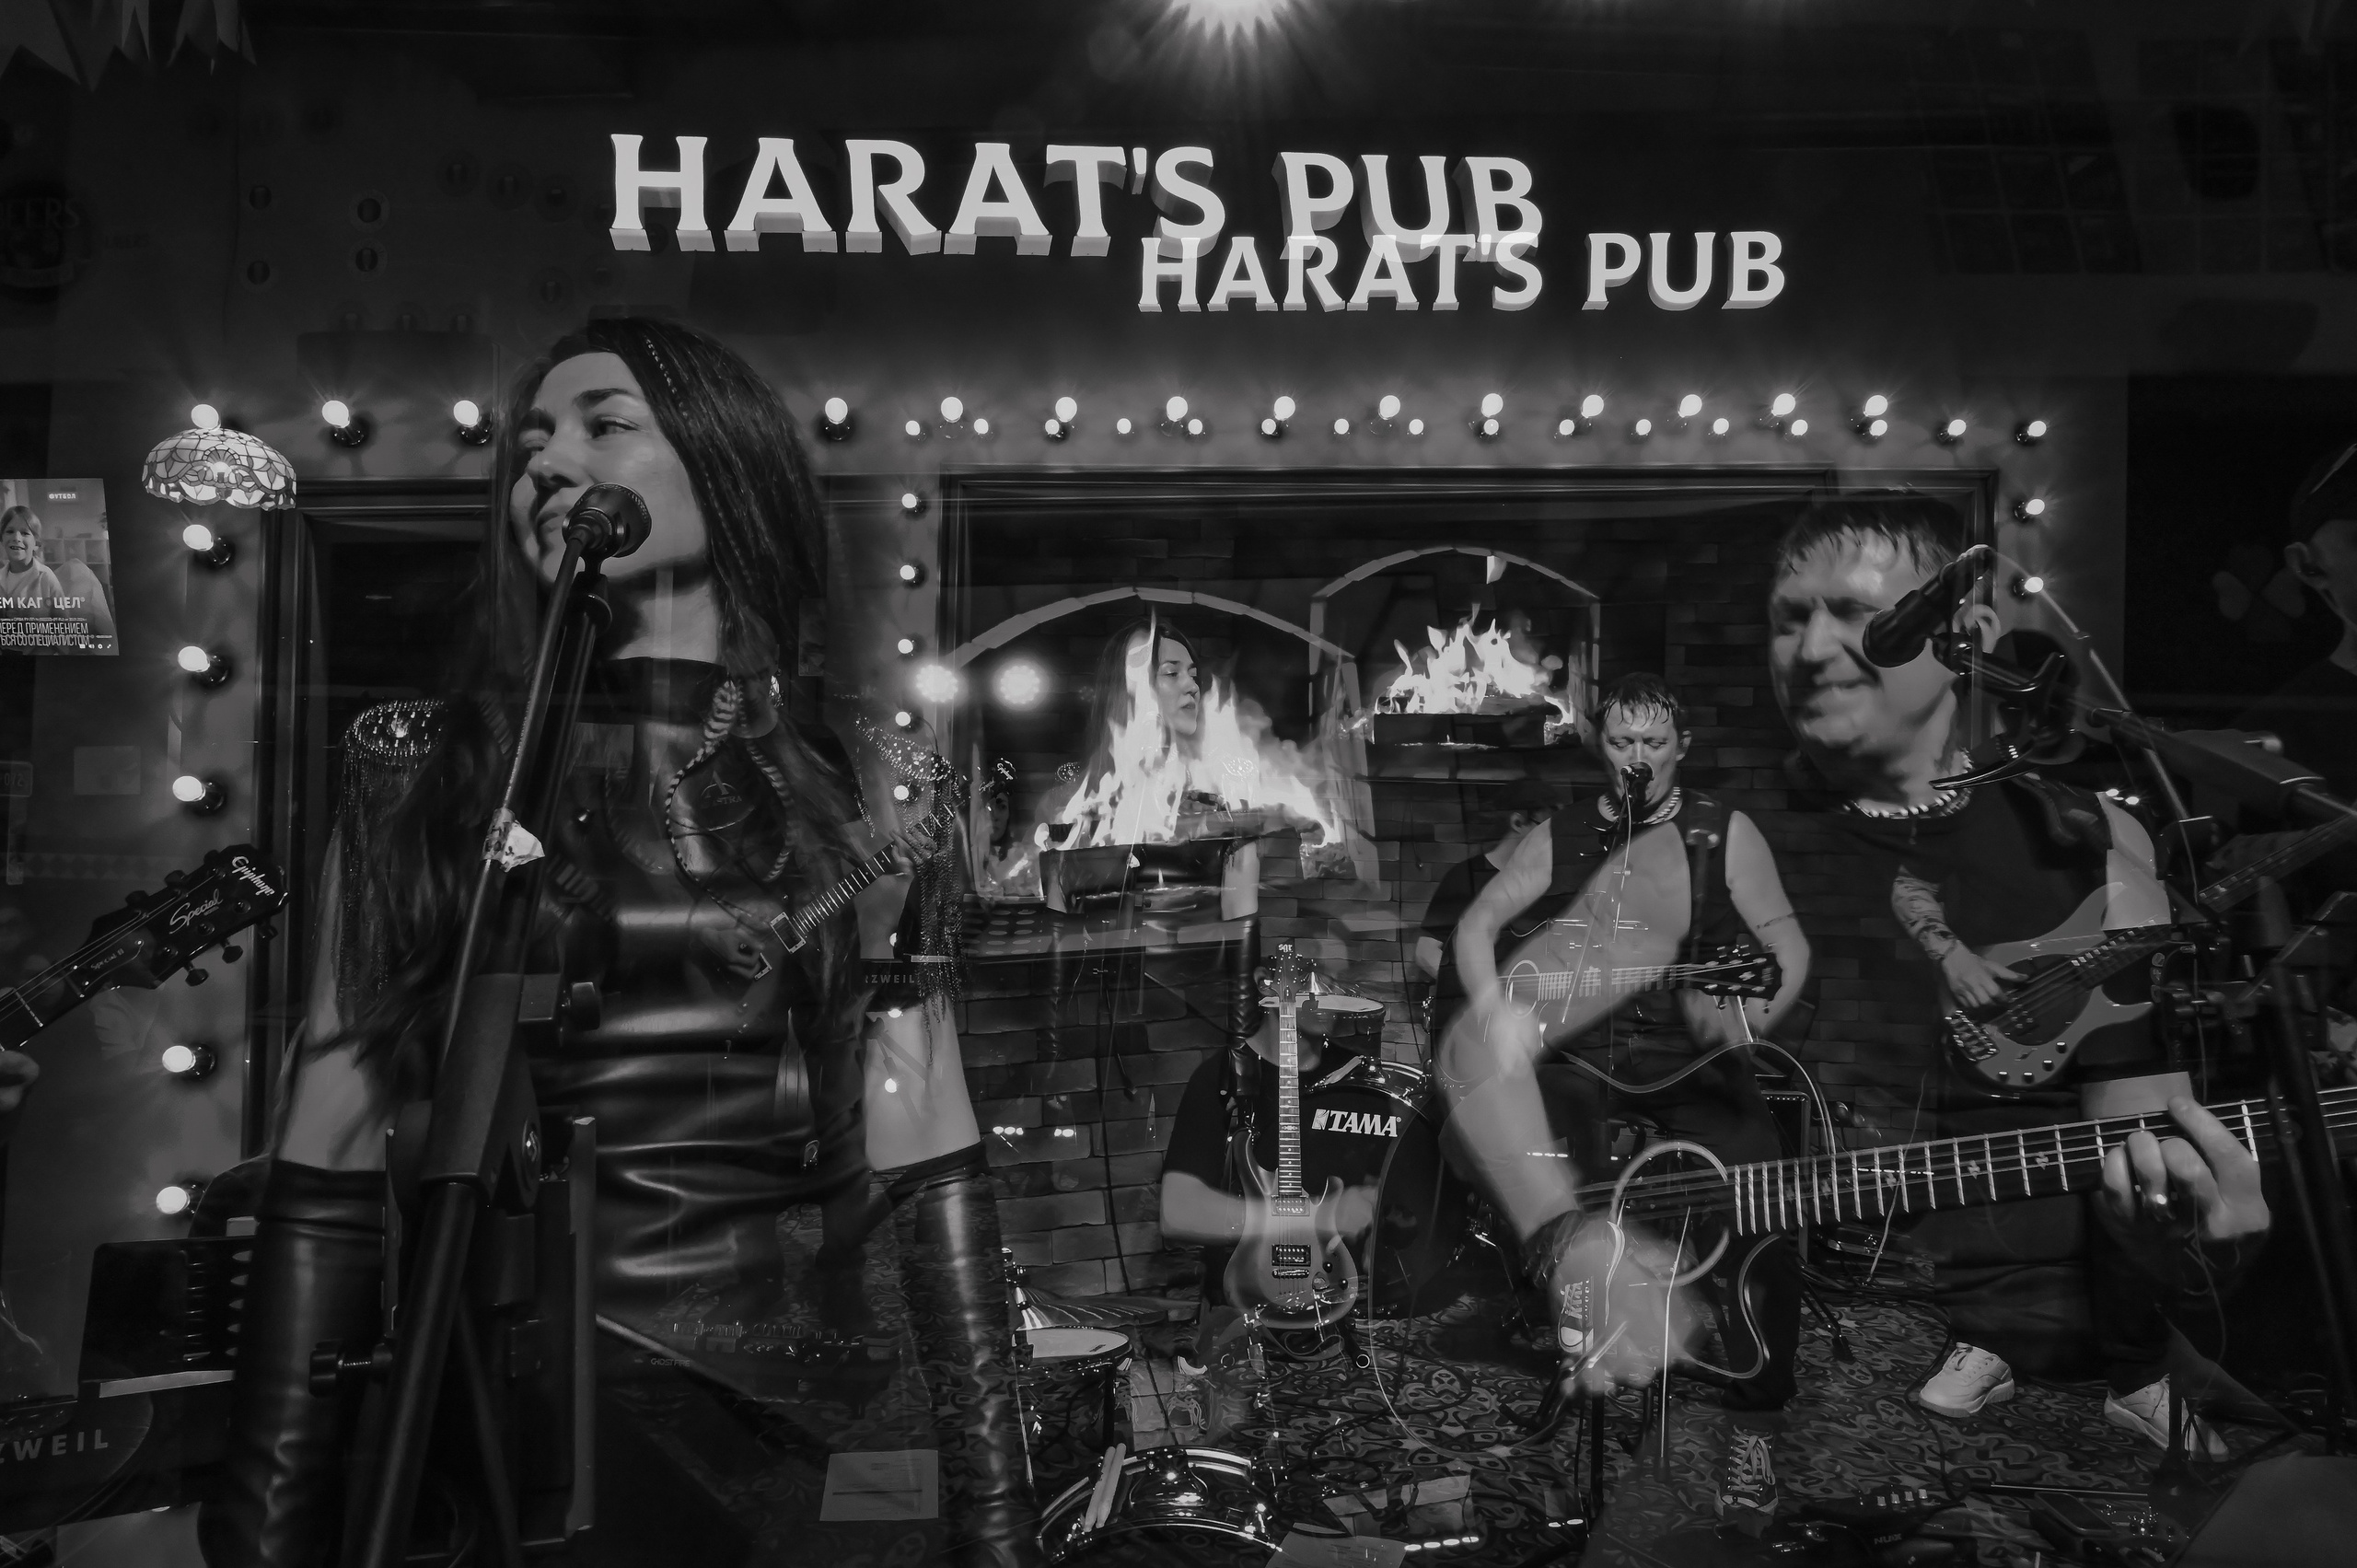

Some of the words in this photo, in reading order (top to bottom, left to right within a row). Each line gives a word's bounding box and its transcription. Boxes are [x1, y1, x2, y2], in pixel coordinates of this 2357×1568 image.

[610, 134, 1226, 259] HARAT'S
[1271, 151, 1544, 263] PUB
[1137, 232, 1544, 312] HARAT'S
[1582, 231, 1786, 311] PUB
[25, 621, 89, 634] ПРИМЕНЕНИЕМ
[231, 855, 275, 897] Epiphone
[168, 889, 224, 935] Special
[1328, 1109, 1398, 1138] TAMA
[0, 1428, 109, 1465] WEIL
